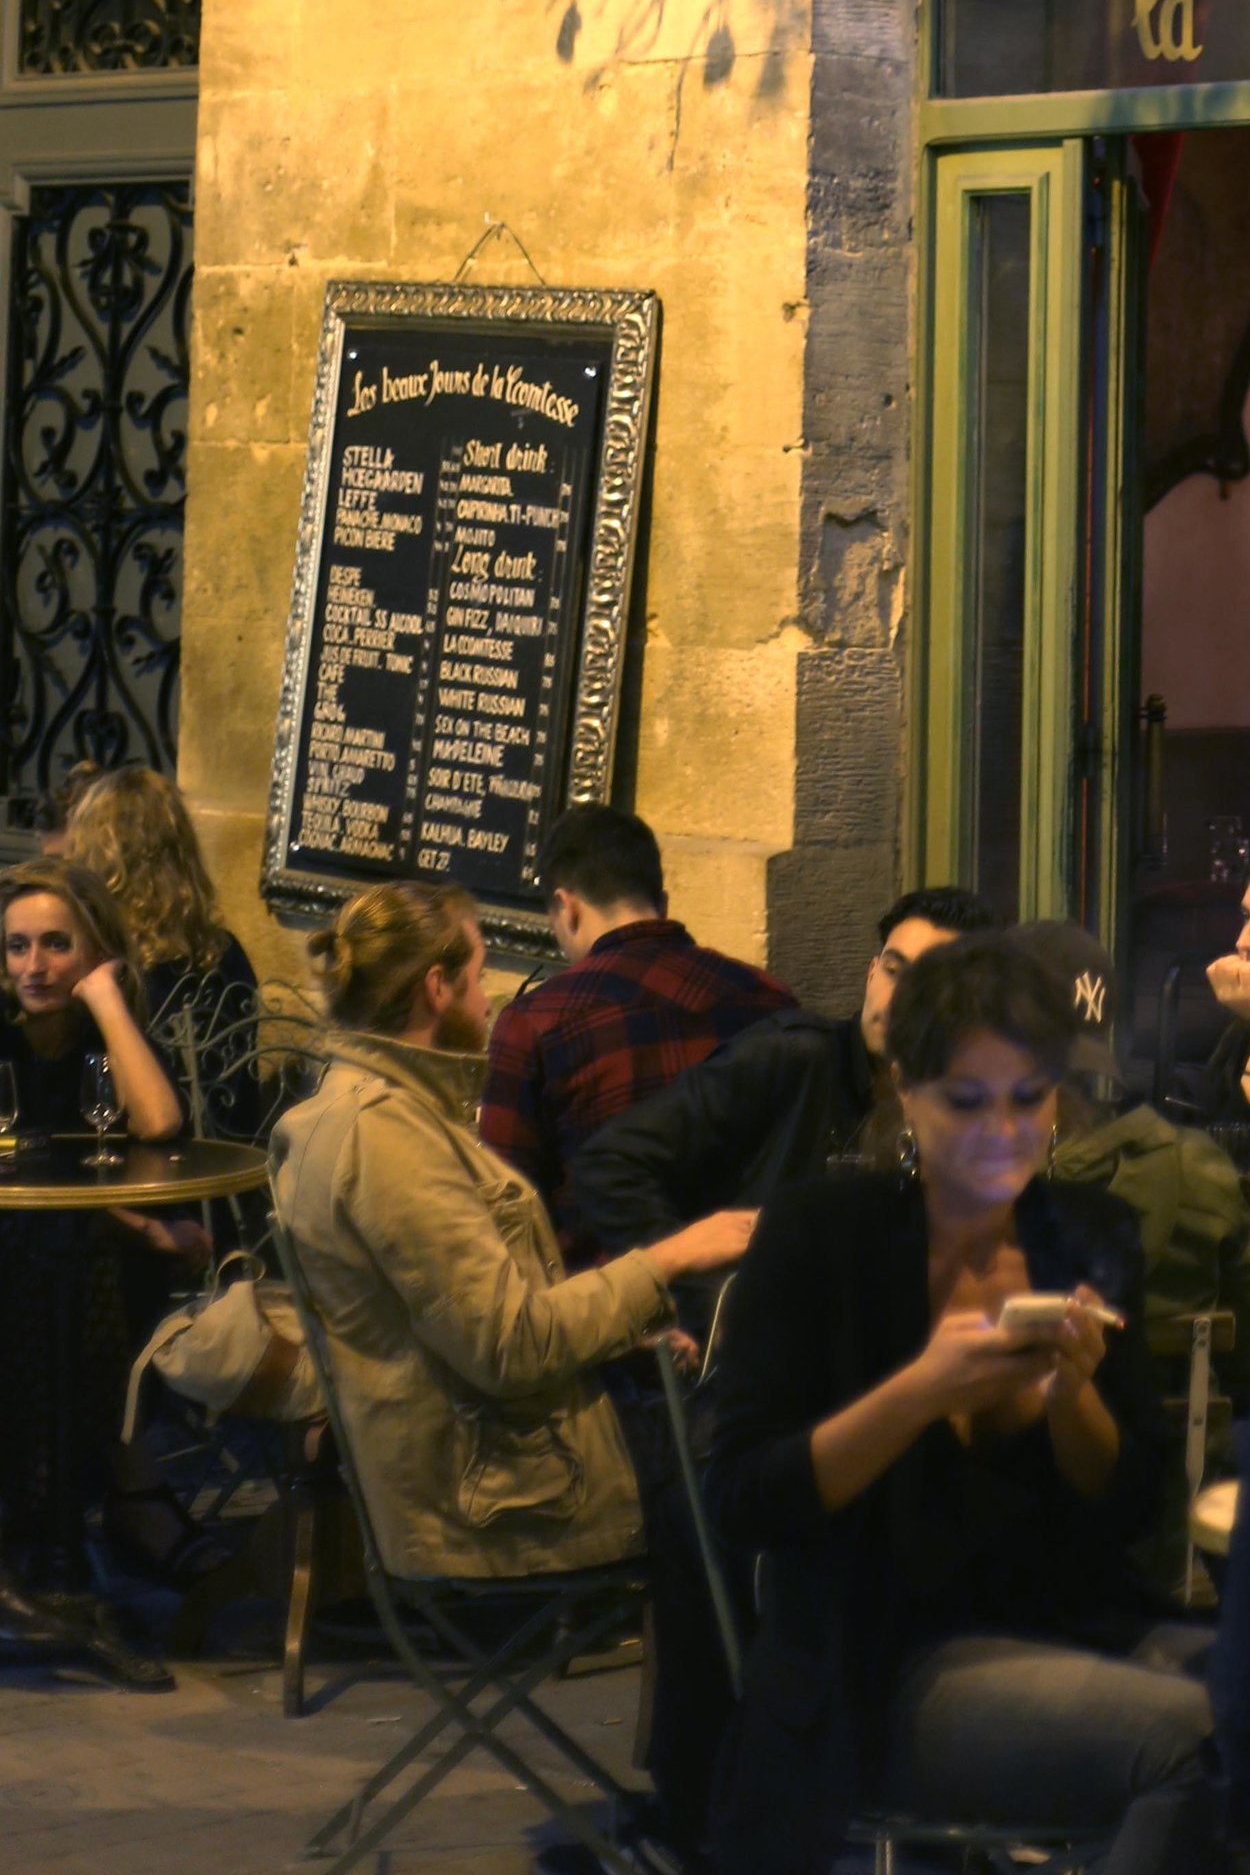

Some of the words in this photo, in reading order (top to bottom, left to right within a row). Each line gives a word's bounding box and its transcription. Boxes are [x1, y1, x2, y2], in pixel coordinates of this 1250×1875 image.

[347, 370, 377, 417] Les
[472, 363, 489, 397] de
[490, 365, 504, 400] la
[343, 445, 395, 470] STELLA
[338, 487, 378, 511] LEFFE
[454, 526, 496, 548] MOJITO
[439, 687, 476, 711] WHITE
[494, 723, 530, 746] BEACH
[1073, 971, 1106, 1023] NY
